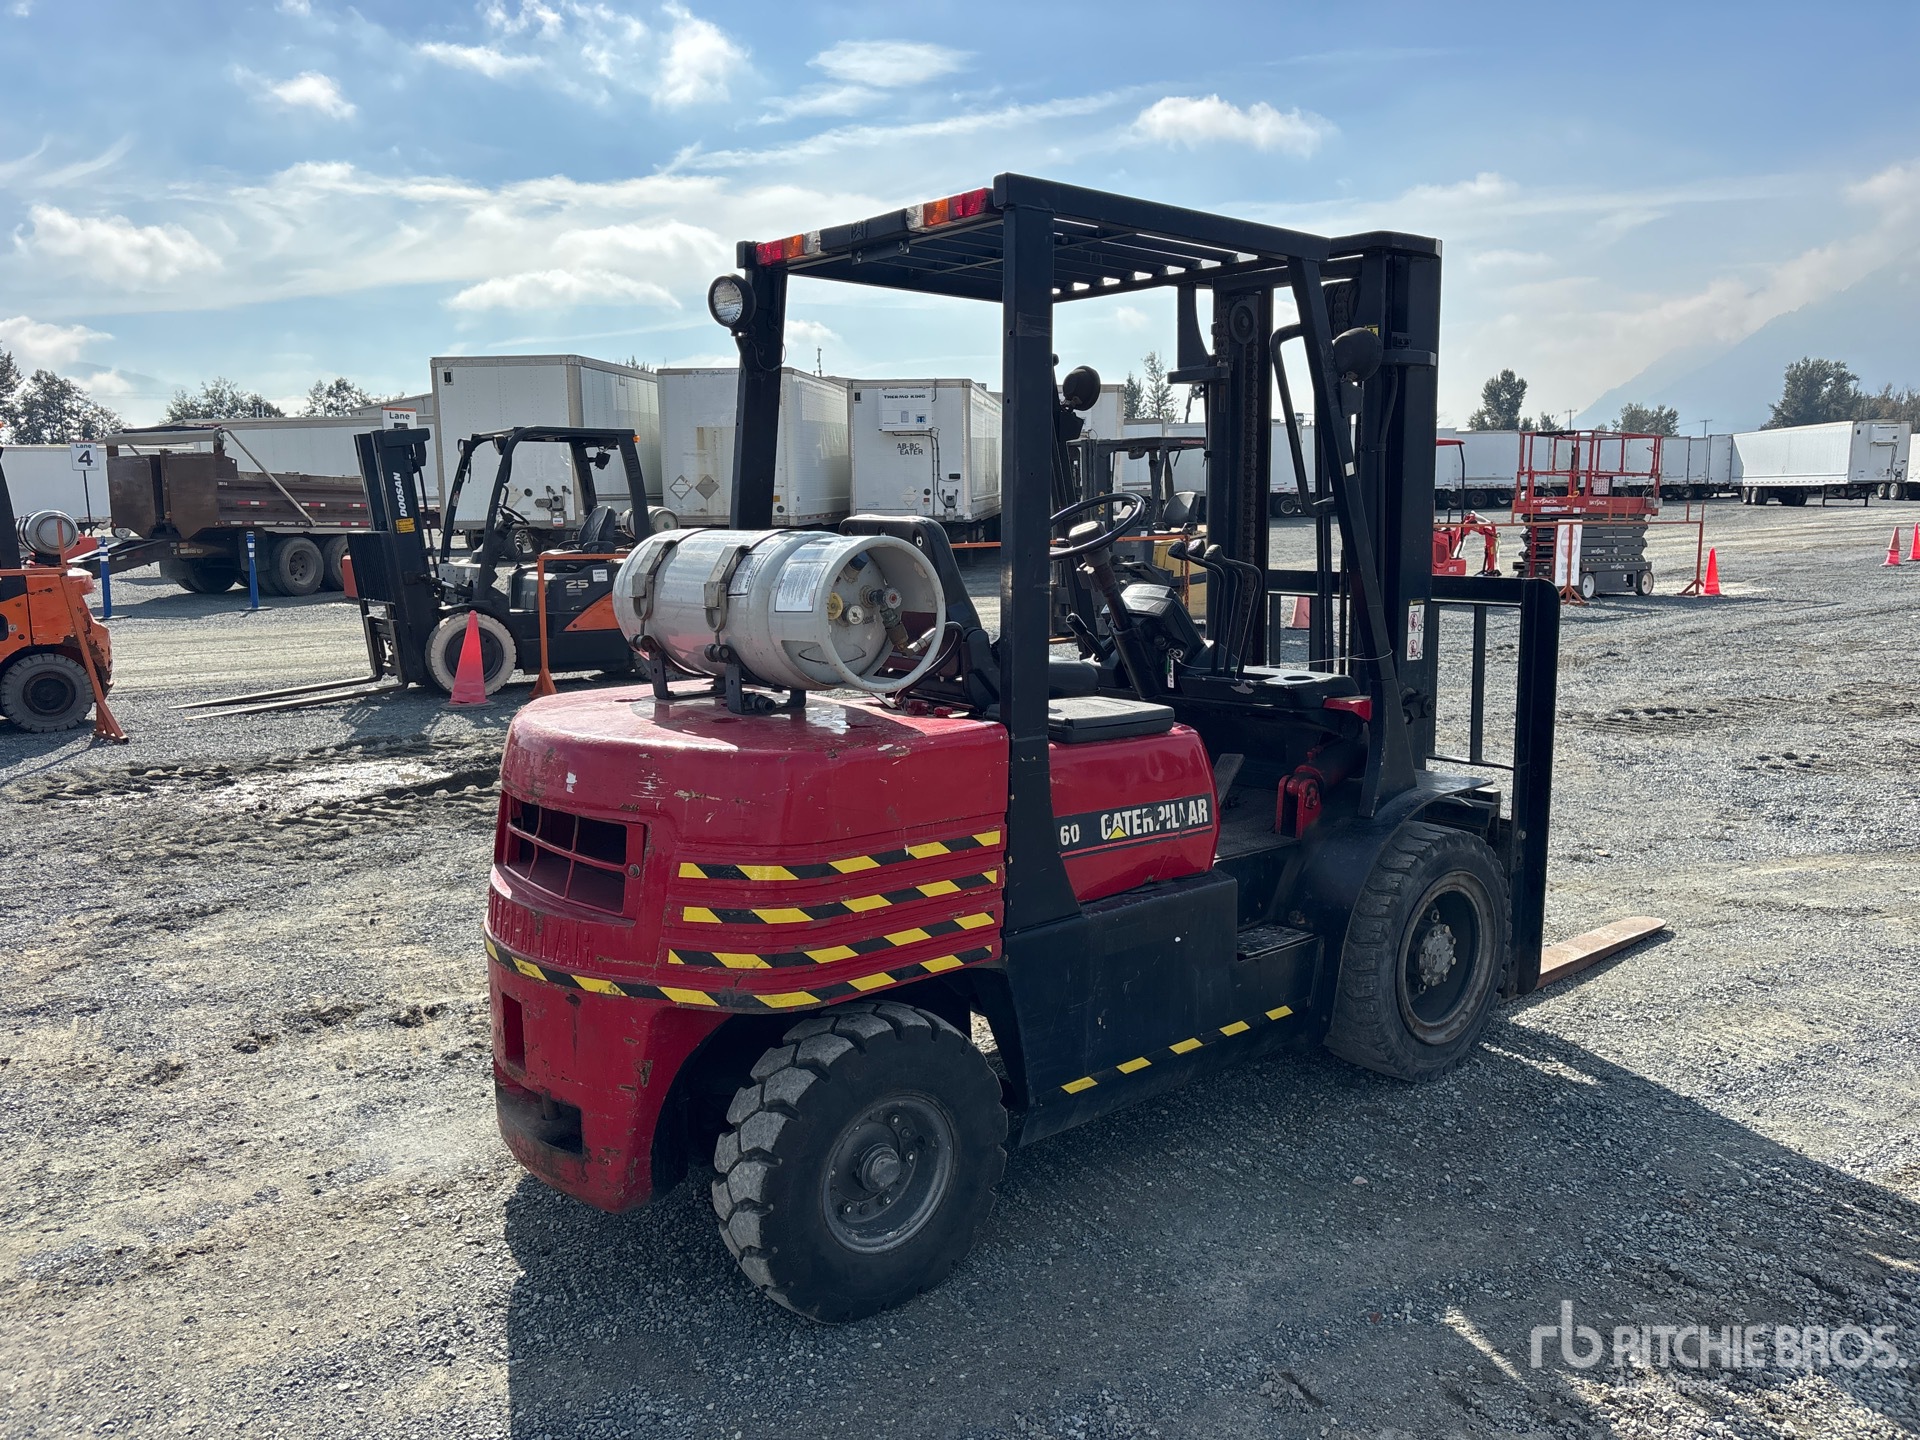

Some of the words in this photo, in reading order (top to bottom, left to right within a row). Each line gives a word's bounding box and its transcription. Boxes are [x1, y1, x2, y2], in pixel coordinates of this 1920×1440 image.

[389, 411, 410, 420] Lane
[896, 442, 920, 450] AB-BC
[78, 450, 93, 466] 4
[393, 472, 407, 517] DOOSAN
[1588, 499, 1607, 507] SKYJACK
[565, 579, 590, 589] 25
[1060, 823, 1081, 846] 60
